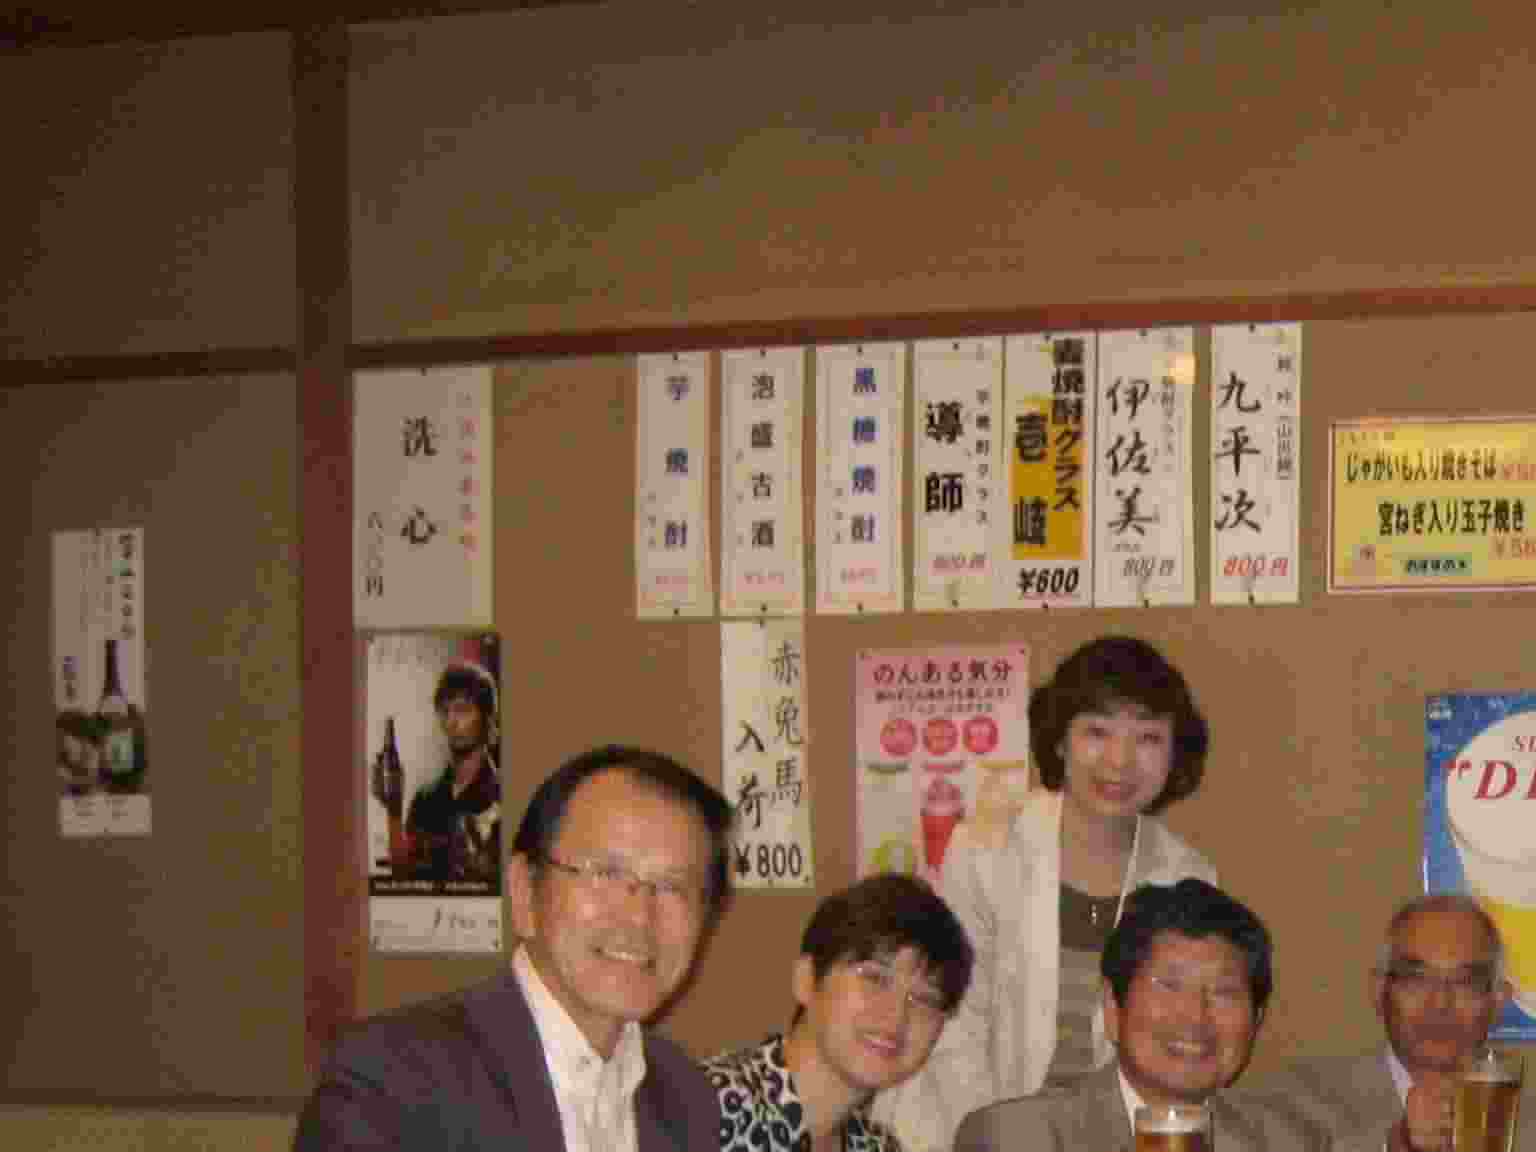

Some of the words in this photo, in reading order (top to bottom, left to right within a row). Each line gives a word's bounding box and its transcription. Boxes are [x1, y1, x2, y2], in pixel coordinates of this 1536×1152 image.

[1104, 375, 1153, 537] 伊佐美
[1213, 370, 1263, 534] 九平次
[1016, 566, 1080, 595] ¥600
[735, 842, 802, 878] ¥800
